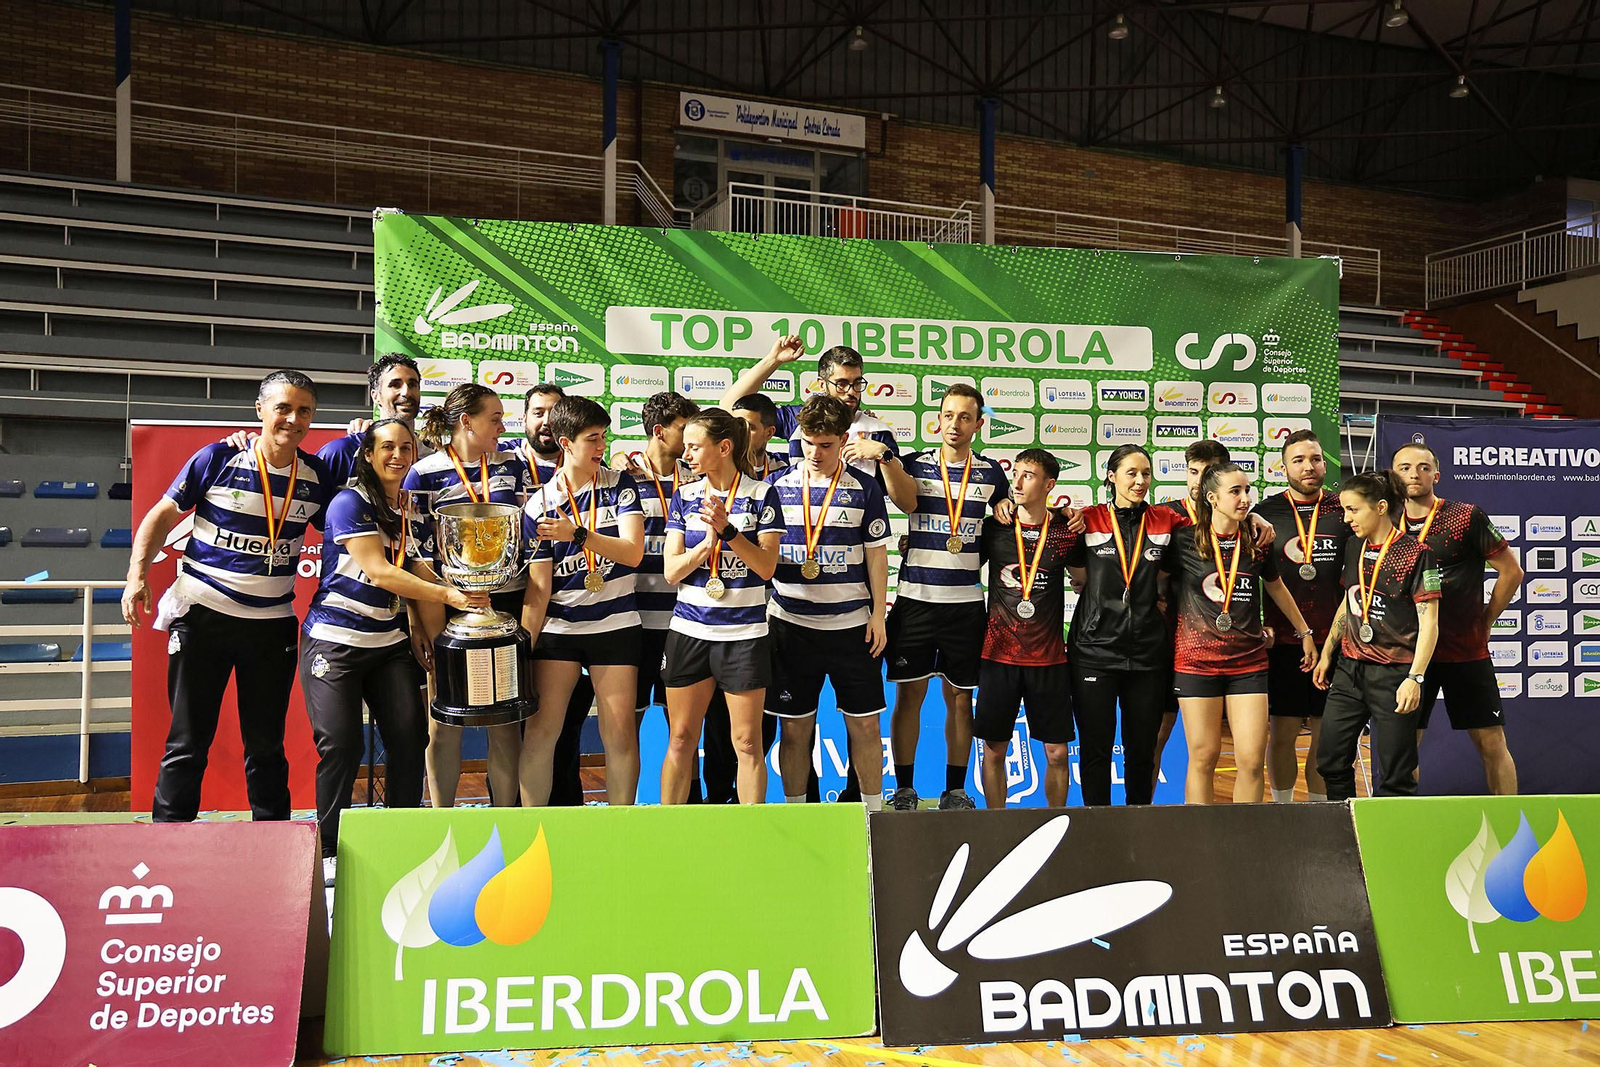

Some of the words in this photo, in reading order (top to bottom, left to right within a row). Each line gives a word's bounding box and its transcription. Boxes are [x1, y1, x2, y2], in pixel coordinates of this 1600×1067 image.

[771, 109, 798, 136] Municipal
[530, 322, 578, 332] ESPAÑA
[441, 332, 578, 353] BADMINTON
[650, 313, 752, 352] TOP
[771, 318, 825, 355] 10
[842, 321, 1113, 365] IBERDROLA
[1263, 348, 1292, 359] Consejo
[1263, 357, 1294, 366] Superior
[1272, 366, 1306, 374] Deportes
[631, 378, 664, 386] Iberdrola
[762, 380, 788, 390] YONEX
[1119, 391, 1142, 400] YONEX
[1173, 427, 1196, 436] YONEX
[1453, 446, 1600, 468] RECREATIVO
[1454, 473, 1556, 481] www.badmintonlaorden.es
[722, 570, 746, 578] original
[1222, 925, 1358, 956] ESPAÑA
[100, 936, 221, 967] Consejo
[96, 968, 226, 1001] Superior
[1498, 950, 1600, 1004] IBE
[422, 967, 829, 1035] IBERDROLA
[980, 968, 1372, 1032] BADMINTON
[90, 1004, 128, 1030] de
[137, 1002, 274, 1032] Deportes
